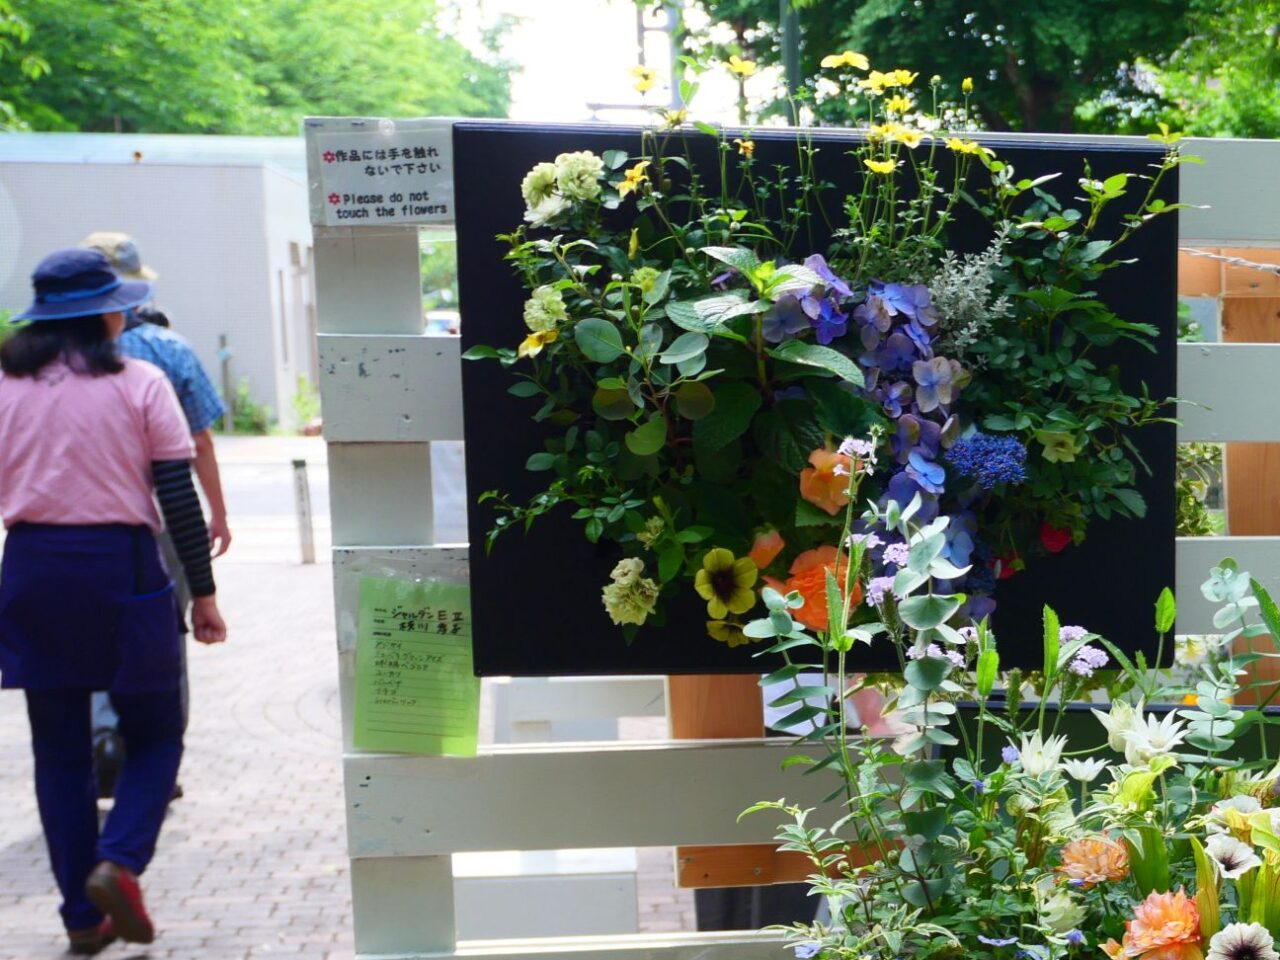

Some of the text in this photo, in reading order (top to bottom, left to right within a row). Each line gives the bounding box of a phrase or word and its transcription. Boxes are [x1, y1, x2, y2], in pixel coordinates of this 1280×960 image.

[335, 147, 439, 162] 作品には手を触れ
[364, 163, 441, 176] ないで下さい
[343, 190, 430, 205] Please do not
[336, 204, 448, 219] touch the flowers
